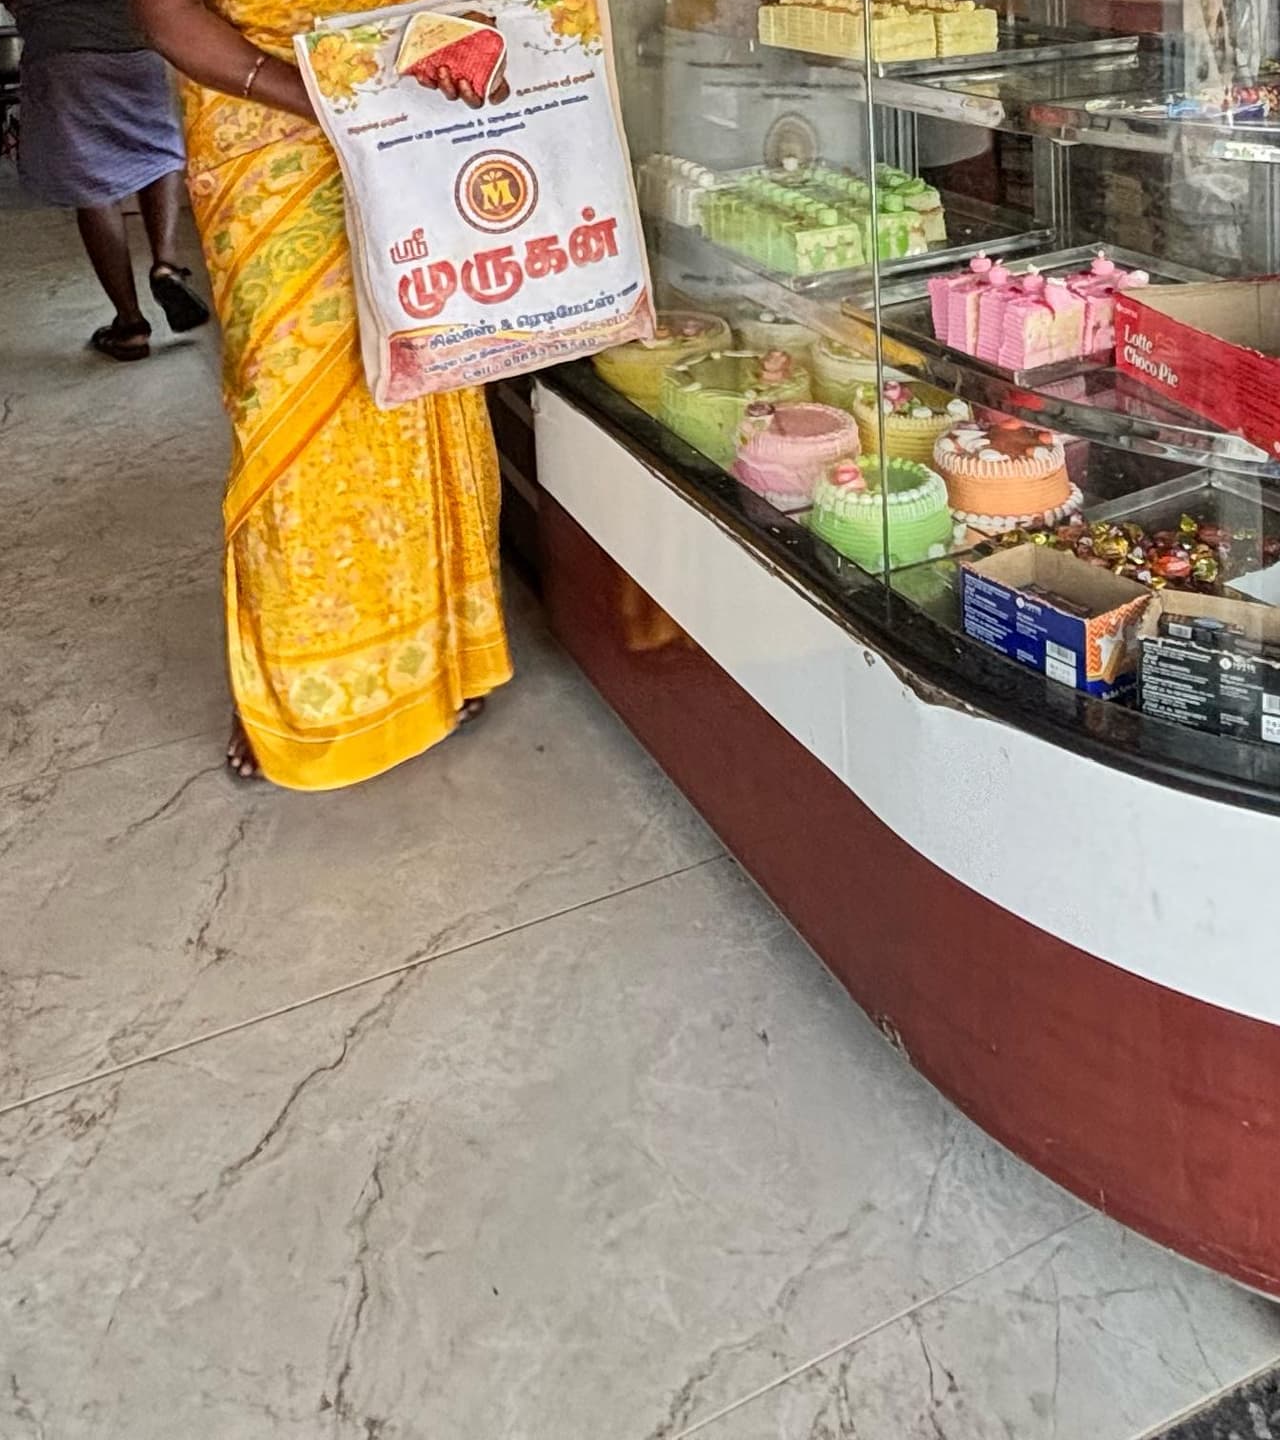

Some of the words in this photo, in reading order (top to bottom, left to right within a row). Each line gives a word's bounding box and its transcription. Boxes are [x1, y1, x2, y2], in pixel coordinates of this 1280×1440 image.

[479, 177, 517, 211] M
[398, 206, 619, 319] முருகன்
[500, 319, 514, 331] &
[1123, 325, 1153, 354] Lotte
[1123, 345, 1158, 378] Choco
[1157, 361, 1180, 388] Pie
